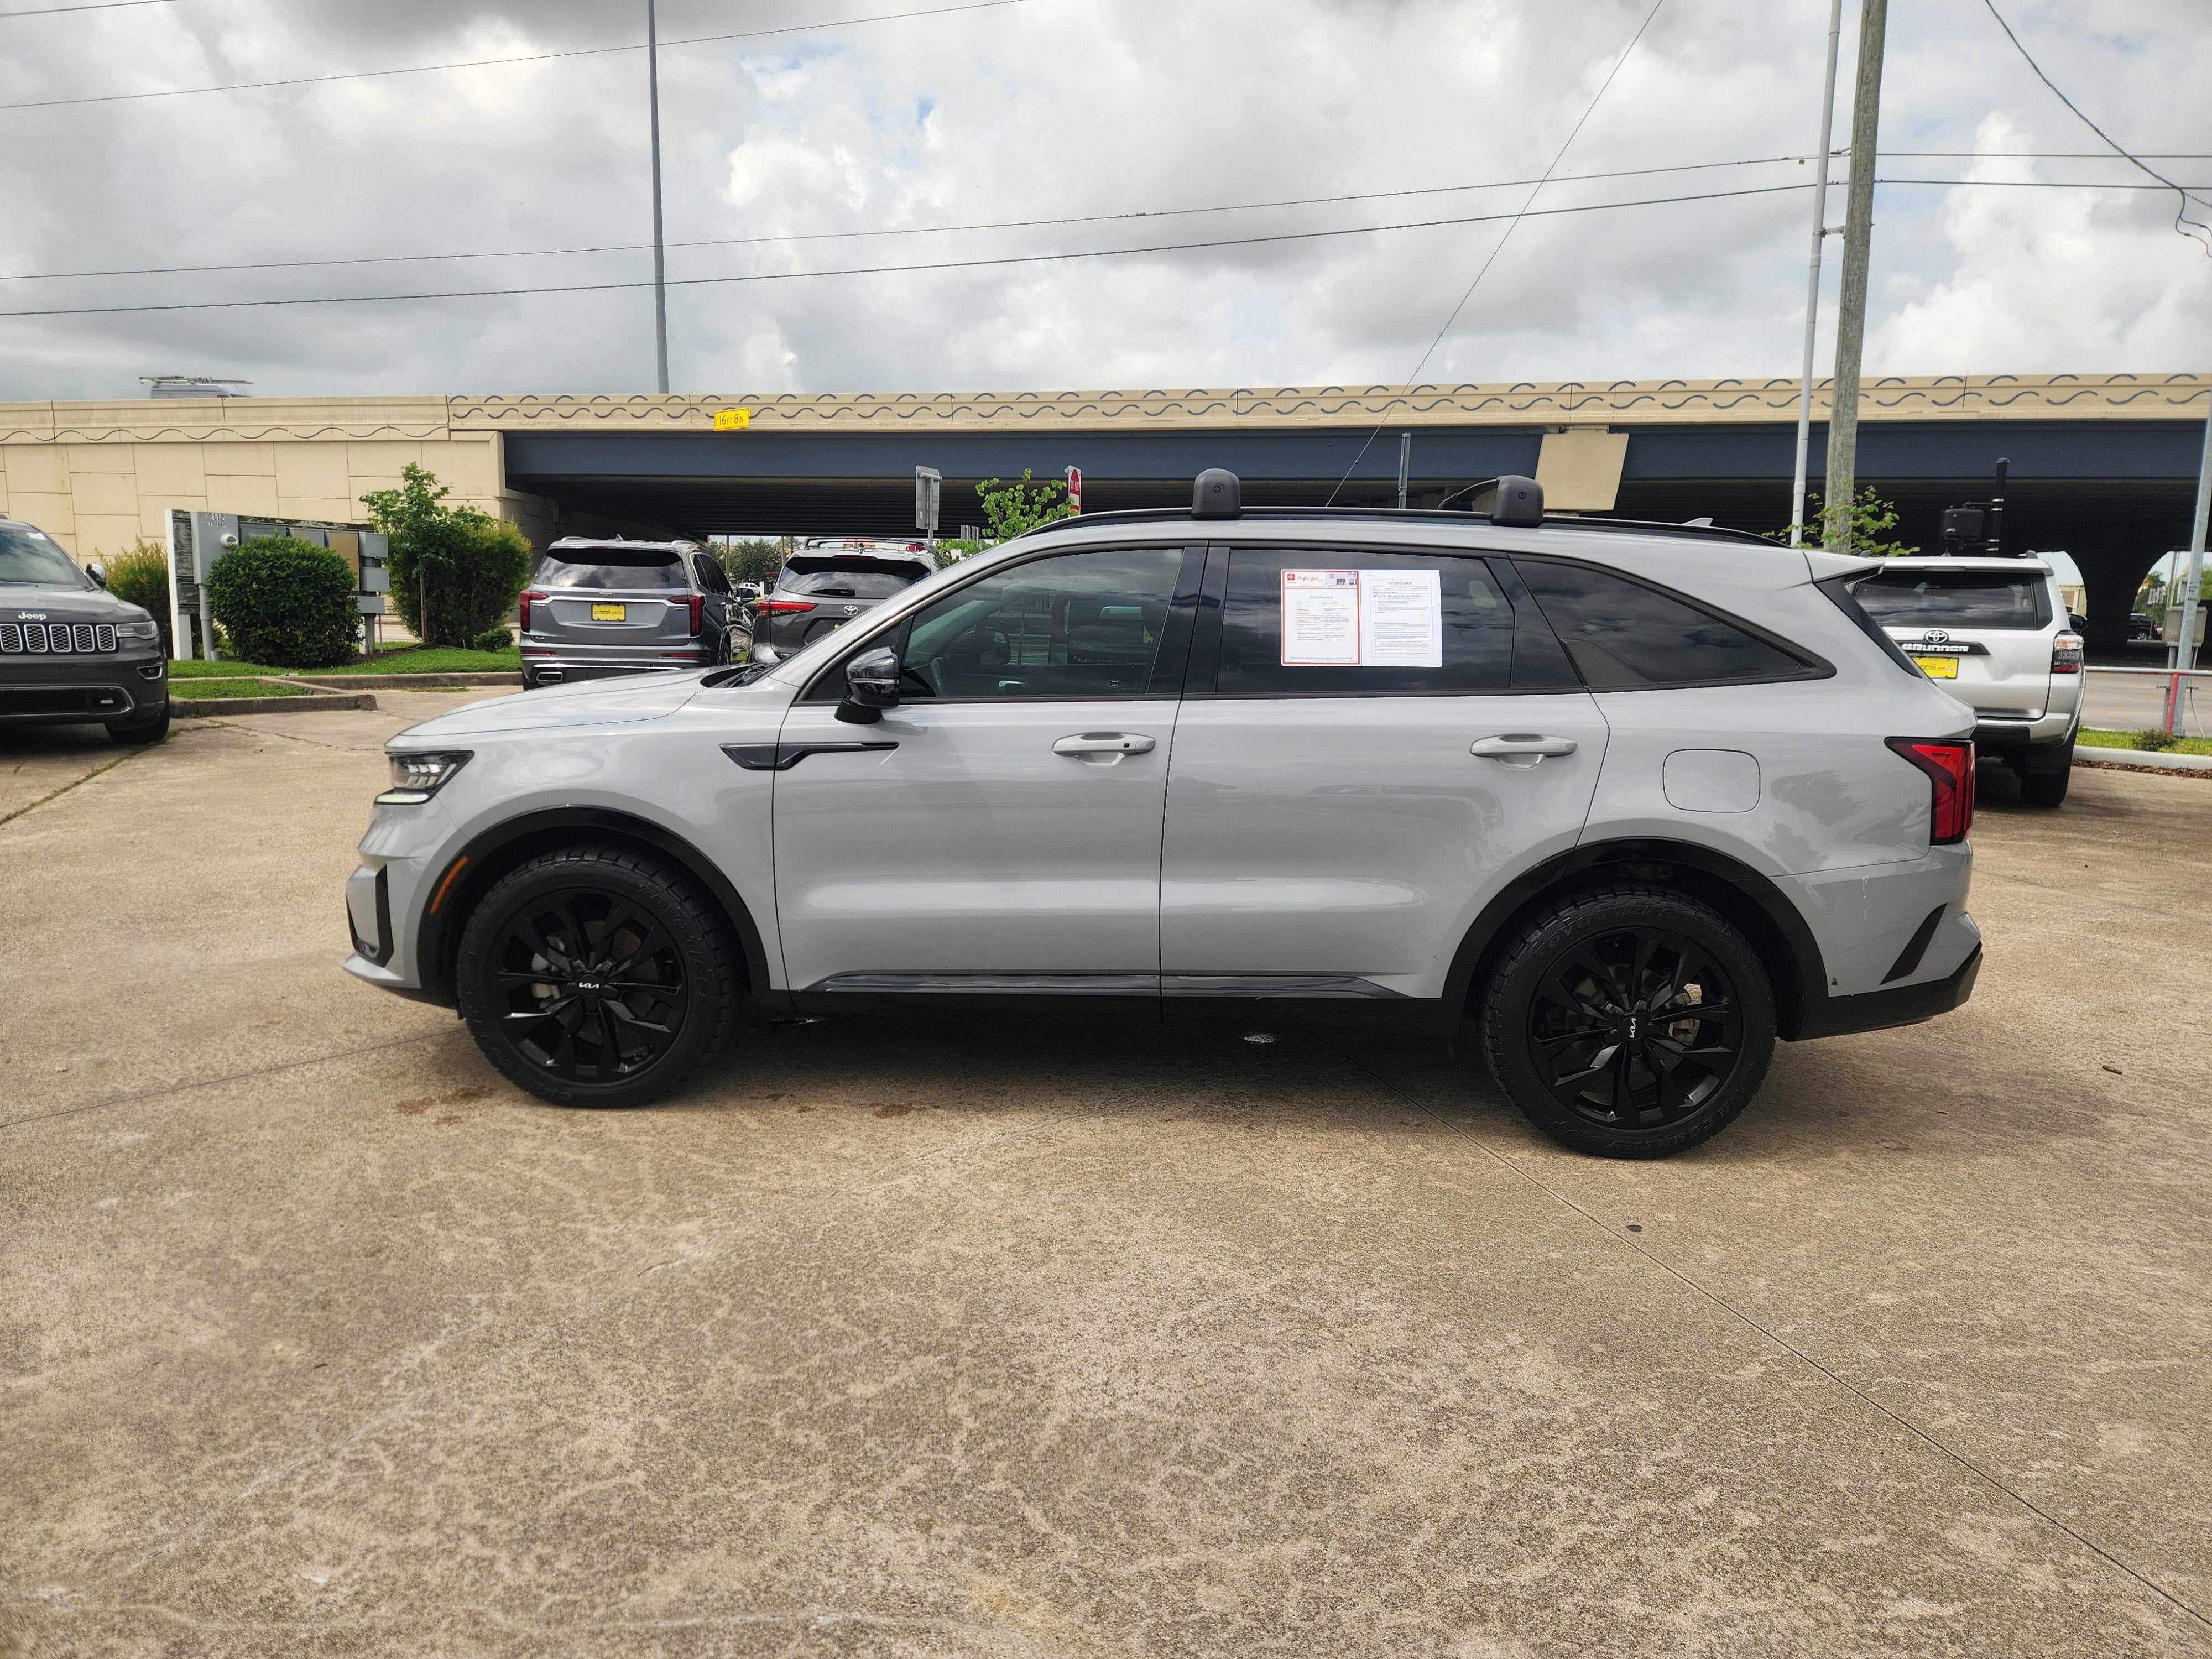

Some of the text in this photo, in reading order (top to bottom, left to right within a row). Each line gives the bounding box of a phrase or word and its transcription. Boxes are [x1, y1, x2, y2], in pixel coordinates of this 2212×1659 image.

[208, 513, 225, 521] 2112
[18, 612, 46, 621] Jeep
[1901, 643, 1969, 653] 4RUNNER
[1531, 914, 1592, 958] TOYO
